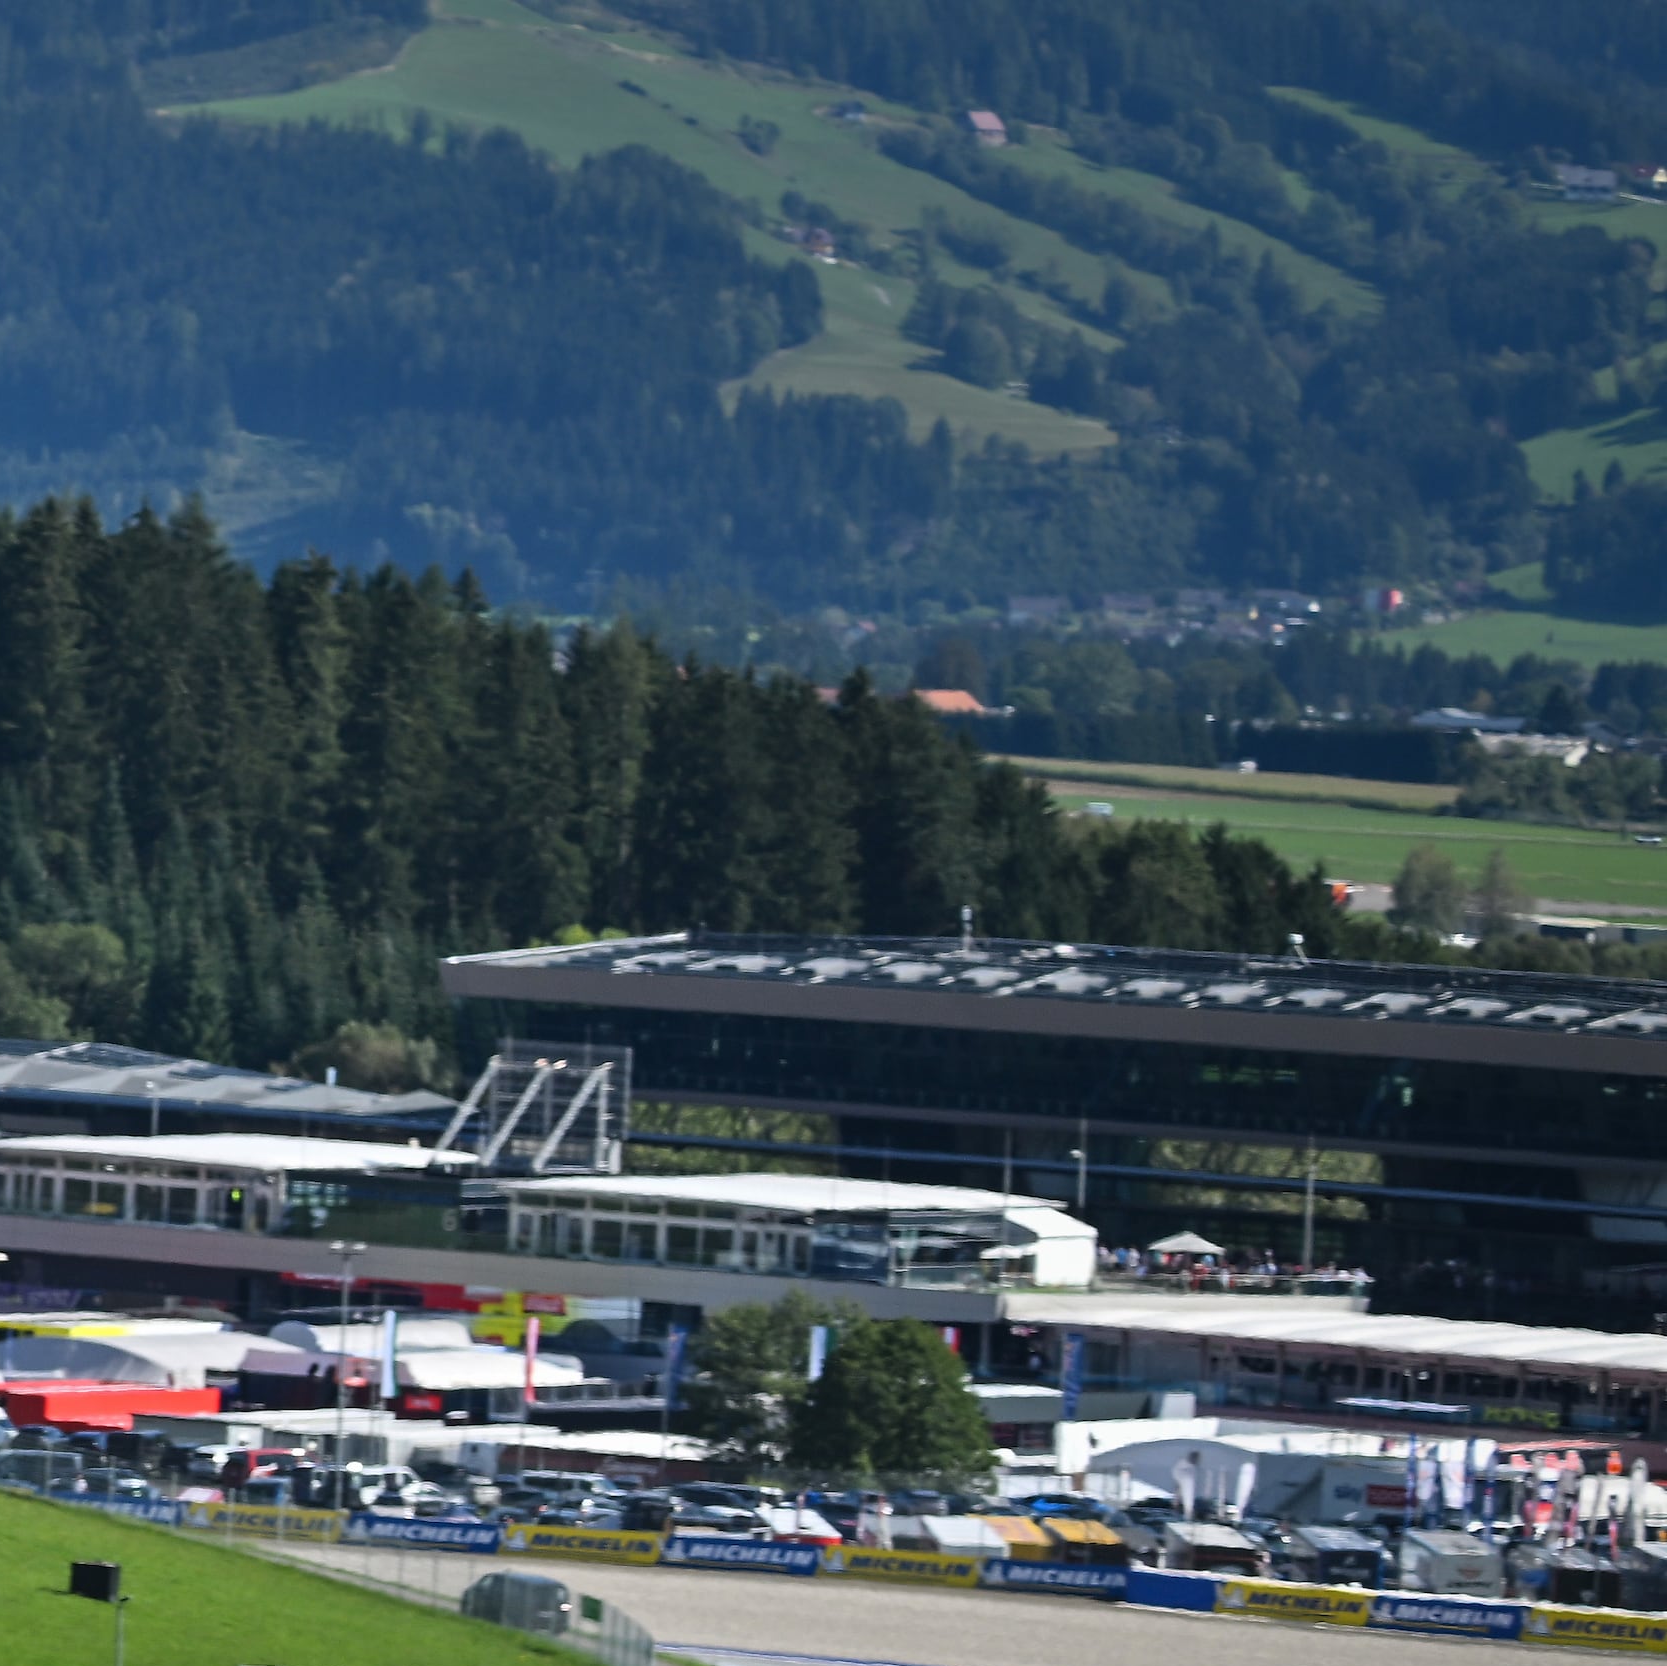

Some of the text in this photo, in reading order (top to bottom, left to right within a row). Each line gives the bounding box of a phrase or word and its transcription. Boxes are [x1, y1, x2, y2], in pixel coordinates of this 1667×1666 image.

[368, 1521, 495, 1545] MICHELIN
[529, 1531, 653, 1555] MICHELIN
[689, 1541, 815, 1567] MICHELIN
[849, 1554, 972, 1579] MICHELIN
[1249, 1590, 1364, 1614] MICHELIN
[1394, 1603, 1513, 1628] MICHELIN
[1553, 1619, 1667, 1642] MICHELIN
